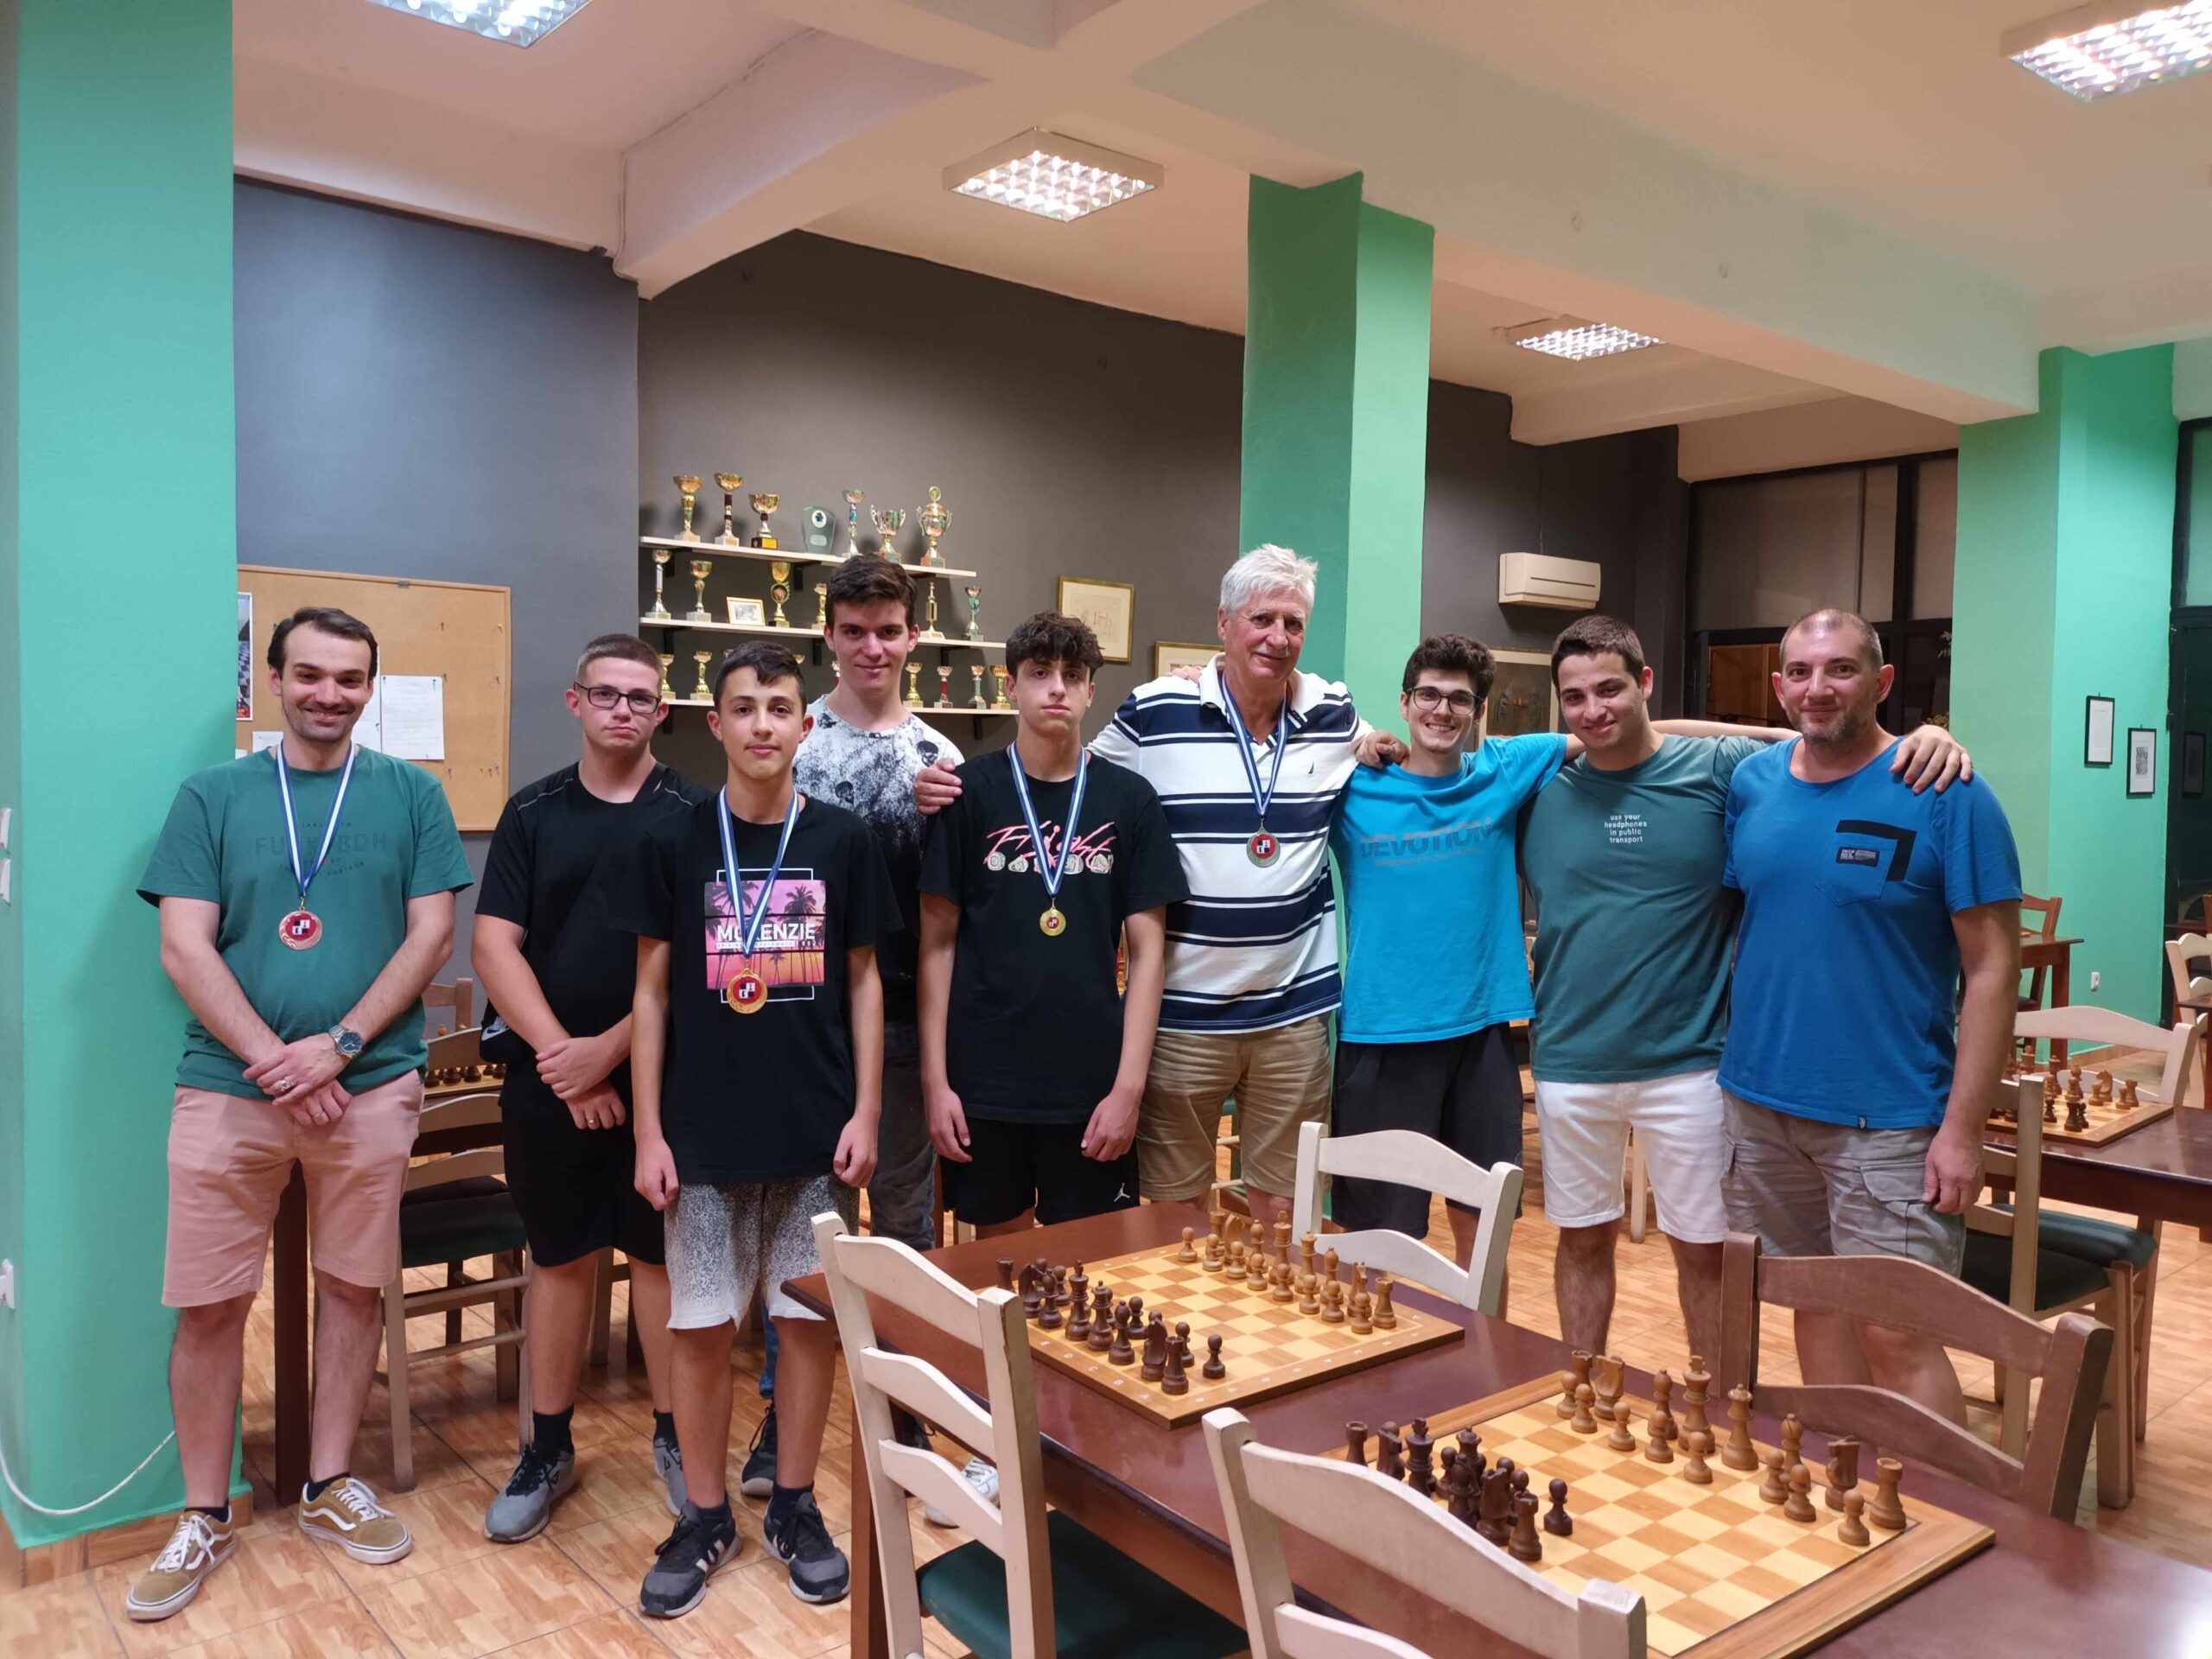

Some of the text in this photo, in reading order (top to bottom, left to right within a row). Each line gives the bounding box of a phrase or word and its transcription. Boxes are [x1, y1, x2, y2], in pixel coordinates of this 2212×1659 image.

[1604, 821, 1647, 830] headphones
[1359, 817, 1493, 858] DEVOTION
[1618, 829, 1642, 837] public
[1609, 836, 1643, 844] transport
[717, 923, 816, 942] MCENZIE
